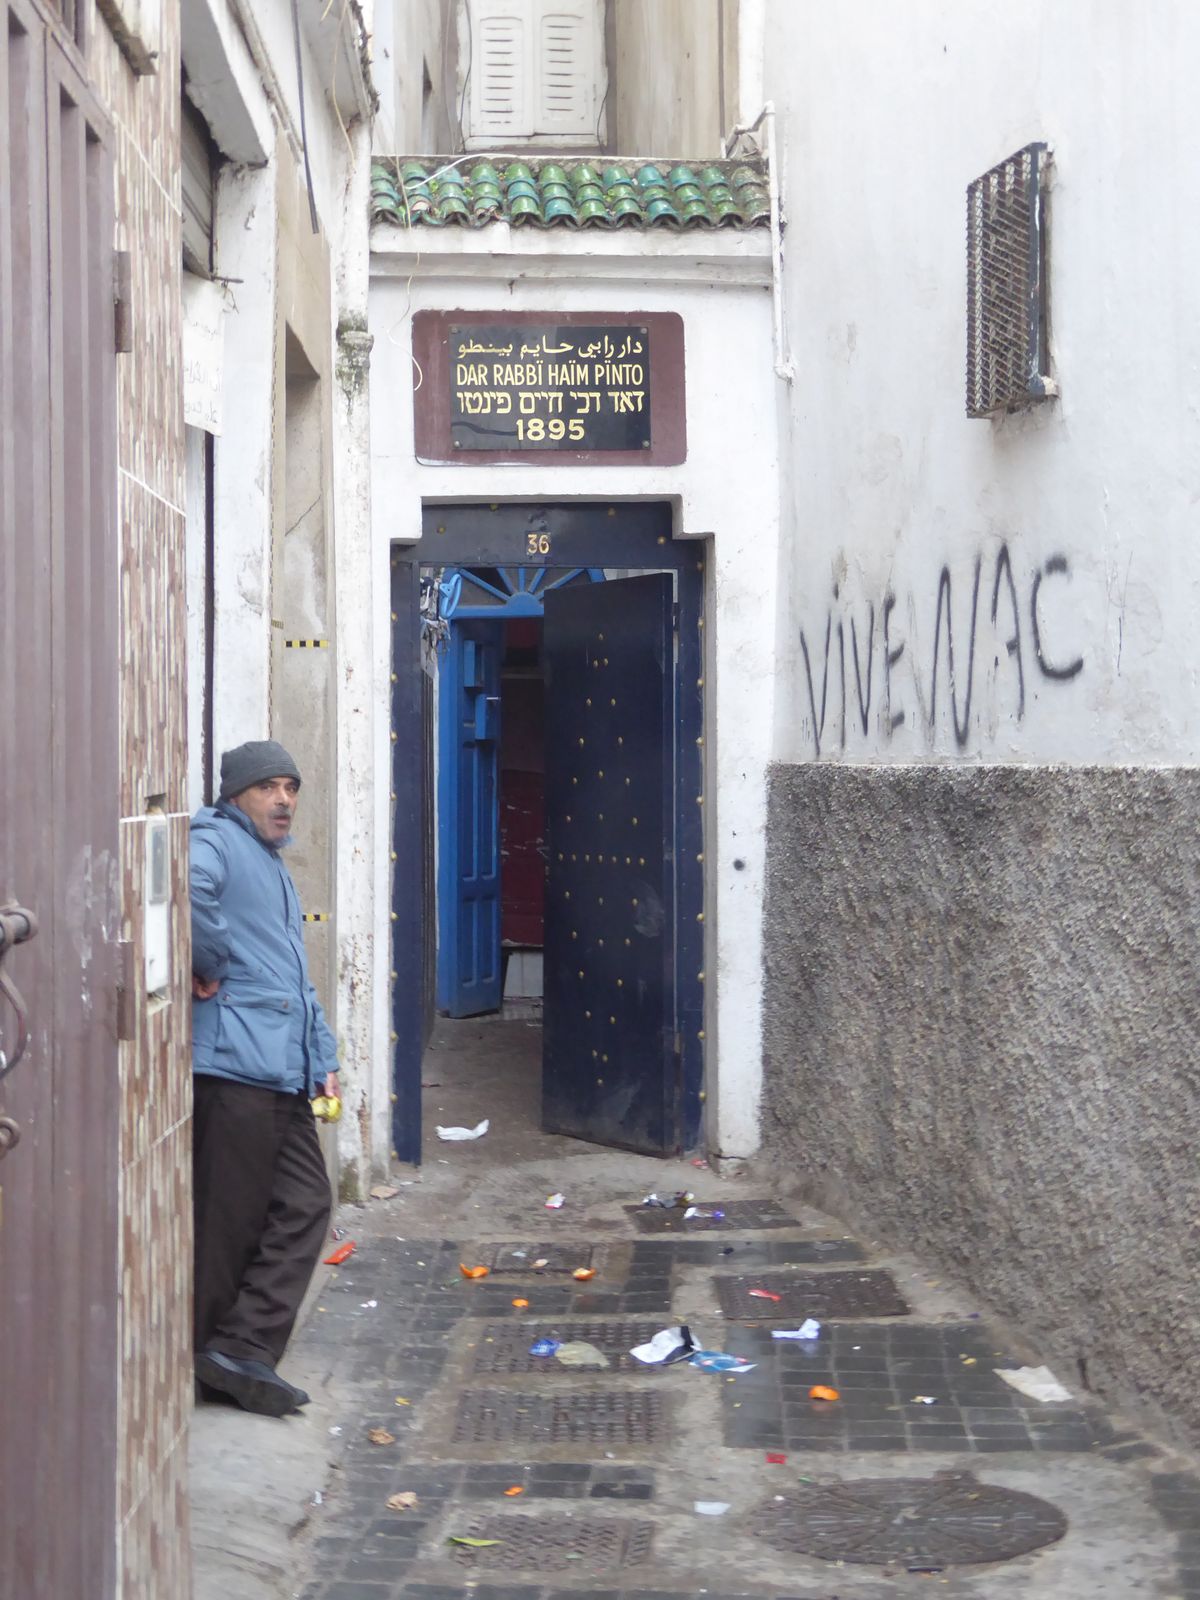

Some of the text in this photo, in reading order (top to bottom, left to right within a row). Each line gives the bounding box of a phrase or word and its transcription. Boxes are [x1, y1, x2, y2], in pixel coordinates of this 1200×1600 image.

[457, 339, 513, 359] بينطو
[578, 335, 614, 358] رابي
[619, 335, 643, 358] دار
[456, 363, 488, 386] DAR
[548, 360, 589, 386] HAÏM
[456, 391, 512, 414] פינטו
[519, 391, 564, 414] חיים
[515, 418, 586, 441] 1895
[527, 533, 550, 554] 36
